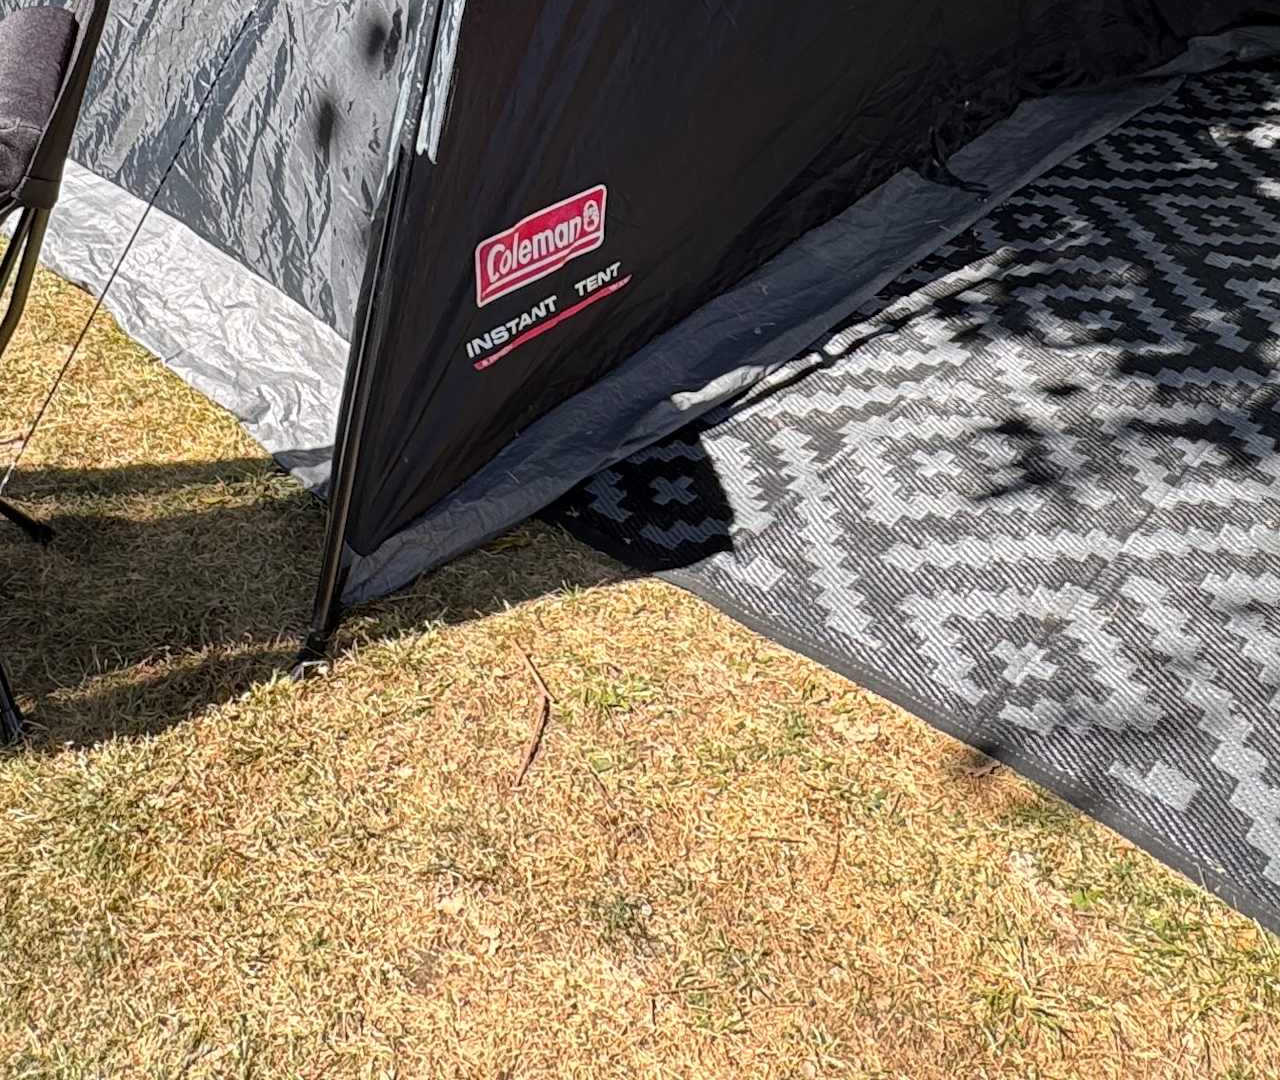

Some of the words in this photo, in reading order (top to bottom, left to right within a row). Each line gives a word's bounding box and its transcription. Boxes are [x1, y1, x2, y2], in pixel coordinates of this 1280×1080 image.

[486, 216, 582, 283] Coleman
[465, 295, 558, 358] INSTANT
[574, 262, 621, 296] TENT
